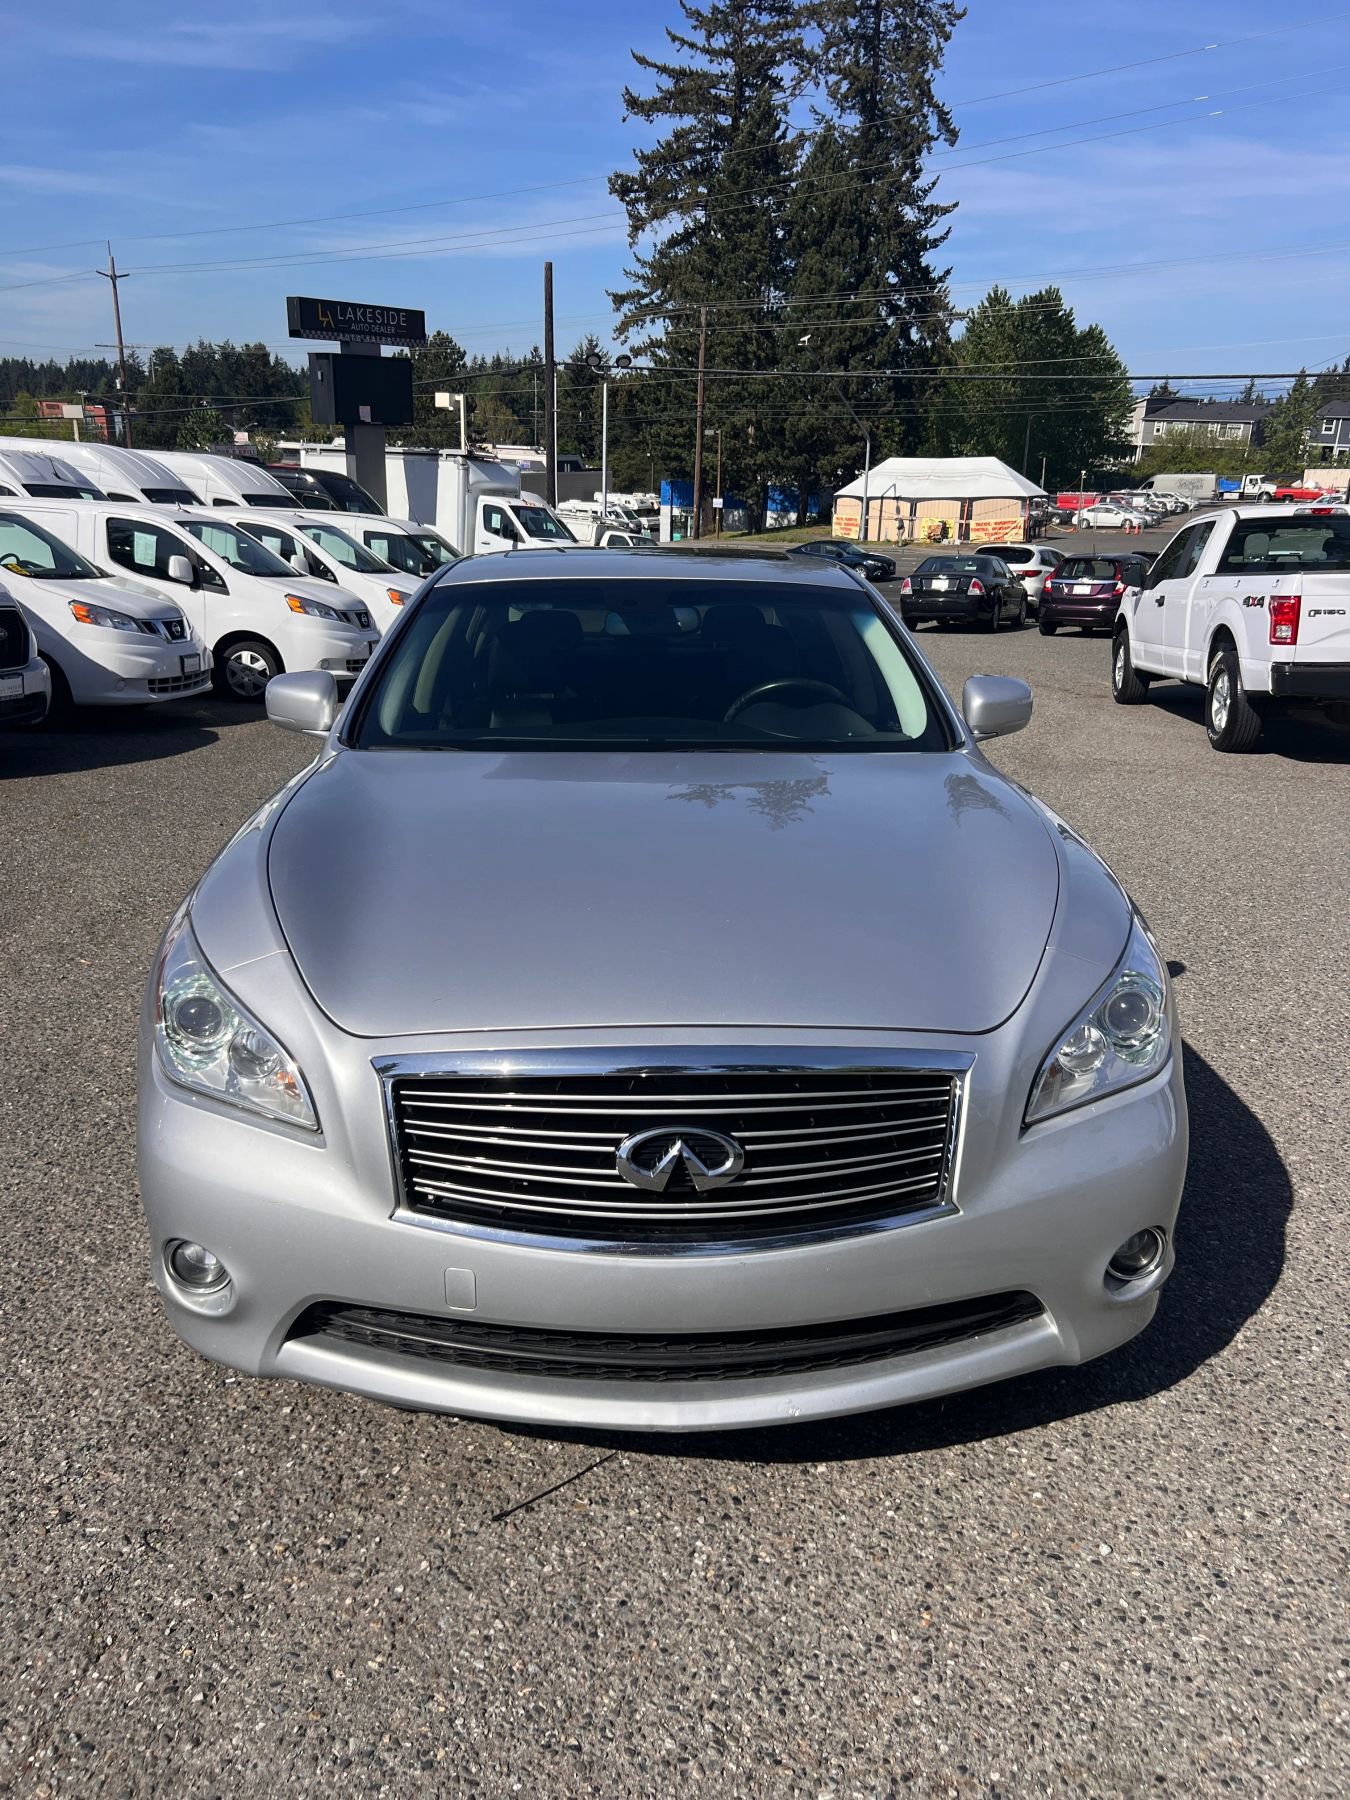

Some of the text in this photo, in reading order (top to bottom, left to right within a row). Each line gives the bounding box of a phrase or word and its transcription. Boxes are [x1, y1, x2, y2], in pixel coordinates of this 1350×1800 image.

[337, 305, 407, 326] LAKESIDE
[351, 322, 396, 334] AUTO DEALER
